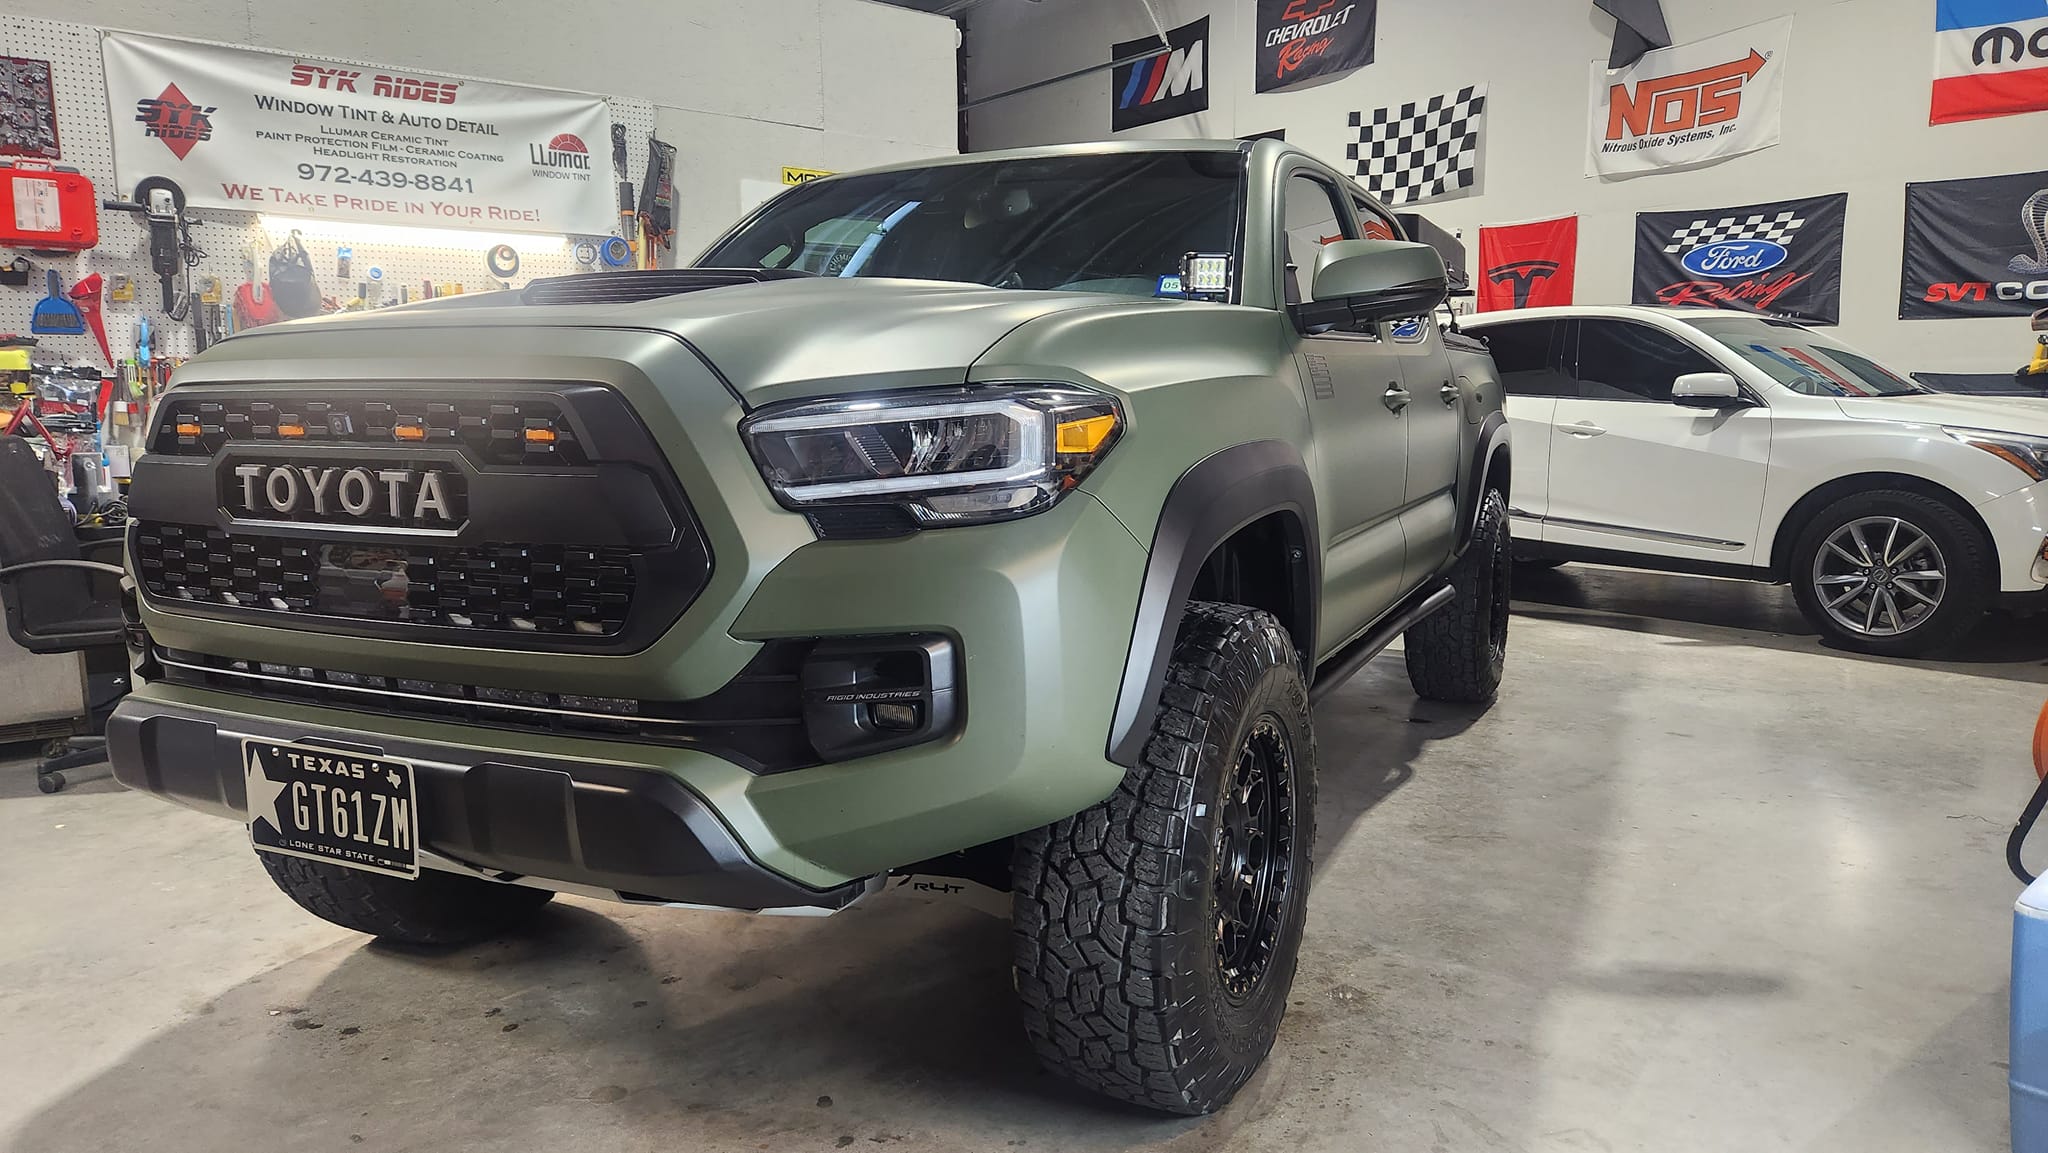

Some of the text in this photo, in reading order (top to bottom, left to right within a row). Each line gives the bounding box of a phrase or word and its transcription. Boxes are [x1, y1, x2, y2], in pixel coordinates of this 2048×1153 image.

[1265, 4, 1356, 47] CHEVROLET
[1278, 37, 1334, 79] Racing
[290, 64, 459, 105] SYK RIDES
[1605, 56, 1750, 141] NOS
[135, 98, 218, 129] SYK
[254, 94, 499, 136] WINDOW TINT & AUTO DETAIL
[145, 122, 213, 142] RIDES
[256, 130, 292, 142] PAINT
[295, 133, 369, 149] PROTECTION
[371, 141, 398, 153] FILM
[405, 145, 455, 158] CERAMIC
[457, 150, 504, 163] COATING
[320, 125, 448, 147] LLUMAR CERAMIC TINT
[1601, 123, 1737, 153] Nitrous Oxide Systems, Inc.
[313, 146, 458, 168] HEADLIGHT RESTORATION
[297, 163, 474, 193] 972-439-8841
[532, 169, 591, 181] WINDOW TINT
[221, 183, 541, 222] WE TAKE PRIDE IN YOUR RIDE!
[1701, 244, 1762, 271] Ford
[1163, 281, 1179, 289] 05
[1656, 272, 1814, 310] Racing
[1923, 281, 1992, 303] SVT
[235, 464, 451, 520] TOYOTA
[826, 690, 920, 702] RIGID INDUSTRIES
[287, 753, 365, 779] TEXAS
[292, 780, 410, 850] GT61ZM
[289, 839, 375, 862] LONE STAR STATE
